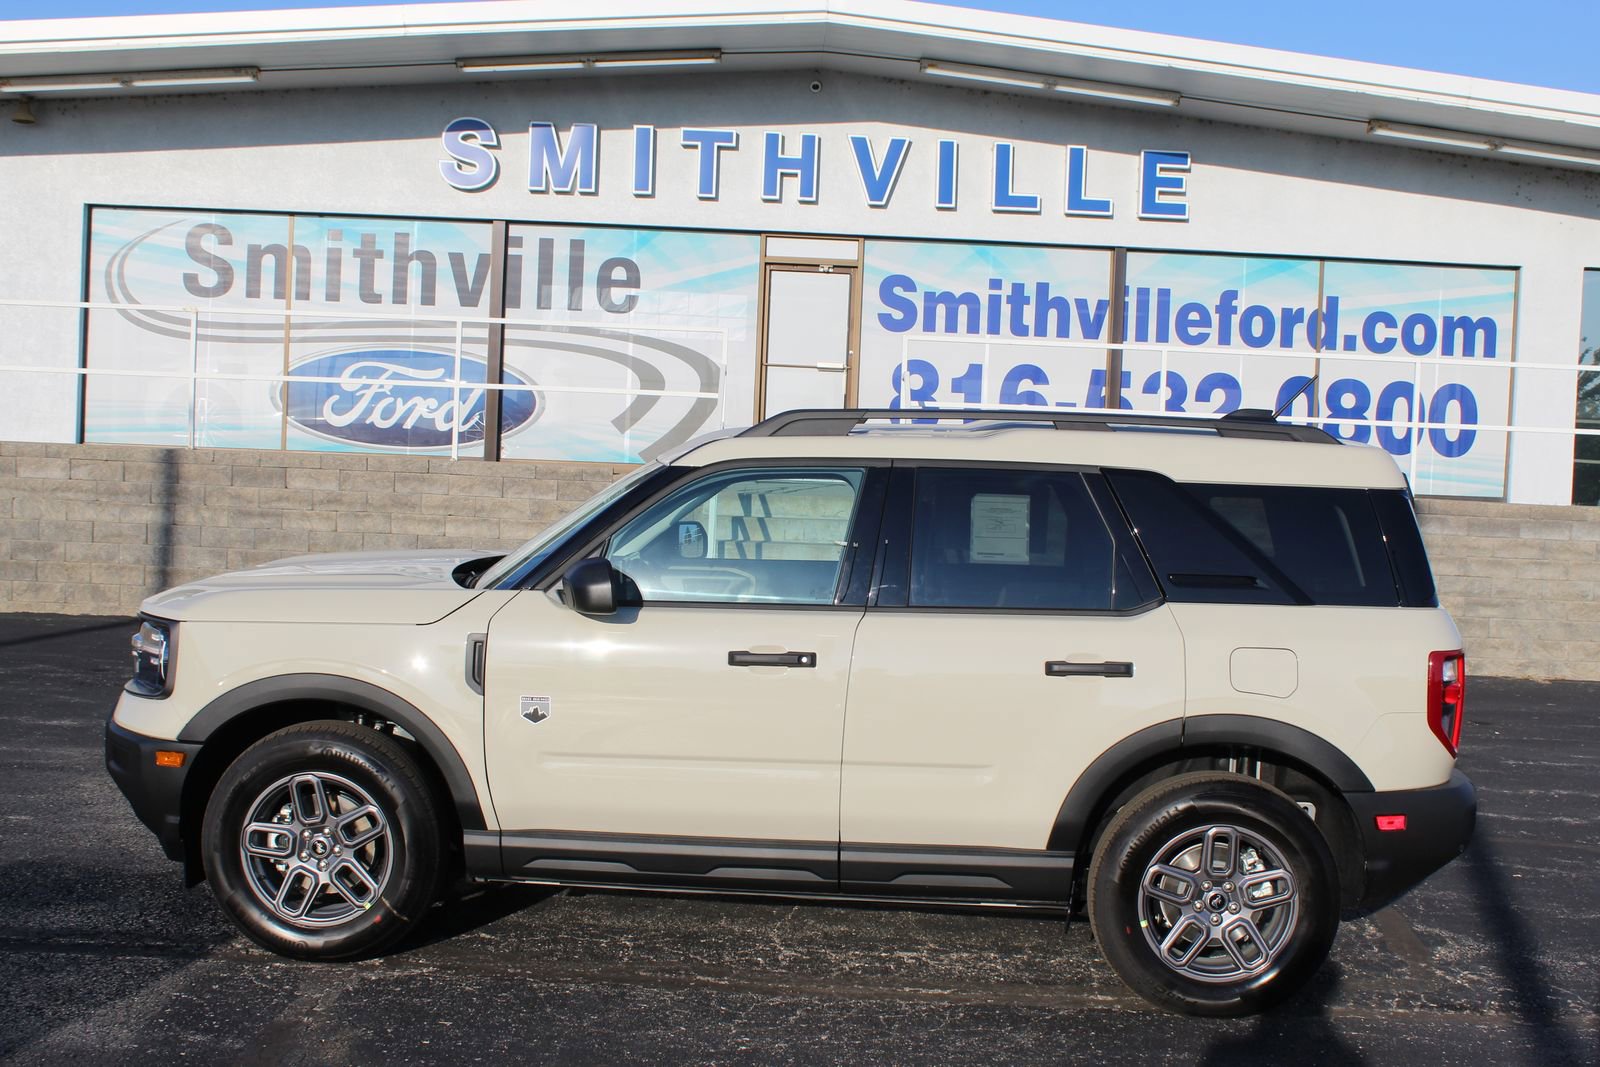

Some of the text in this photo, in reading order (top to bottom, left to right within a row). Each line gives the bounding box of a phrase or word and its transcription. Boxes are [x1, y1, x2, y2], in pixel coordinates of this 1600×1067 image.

[439, 116, 1192, 221] SMITHVILLE
[184, 223, 641, 314] Smithville
[322, 361, 484, 432] Ford
[889, 359, 1478, 458] 816-320800
